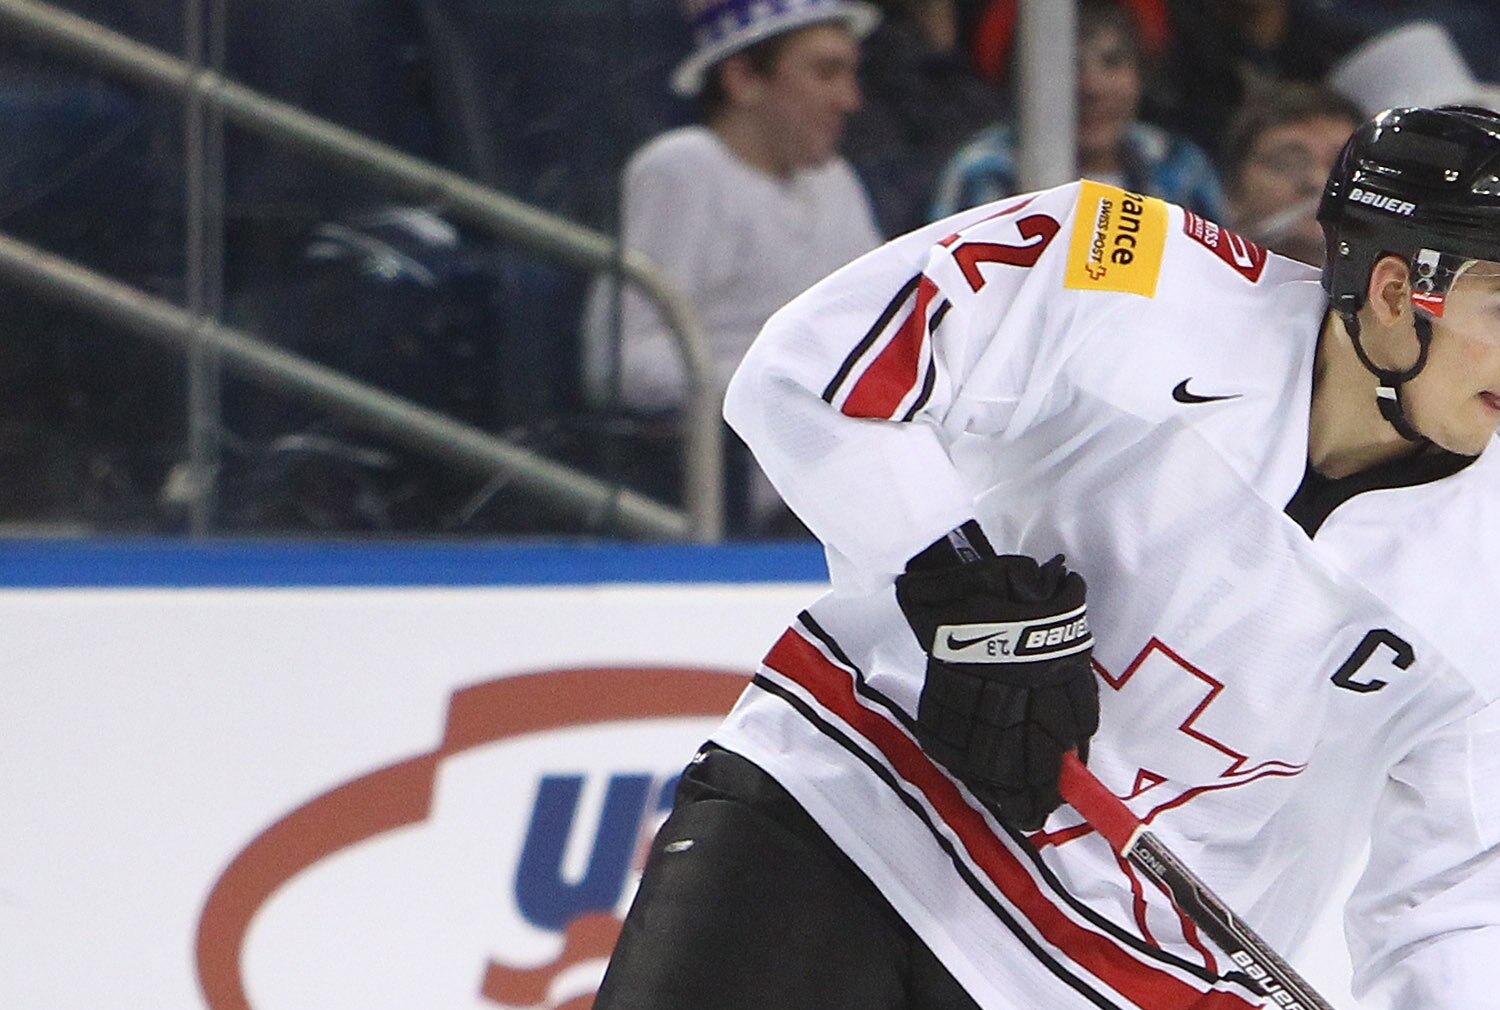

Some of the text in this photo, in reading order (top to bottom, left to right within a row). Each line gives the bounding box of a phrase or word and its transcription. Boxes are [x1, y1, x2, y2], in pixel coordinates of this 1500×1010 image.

[1091, 199, 1113, 263] SWISS POST
[1331, 629, 1416, 693] C
